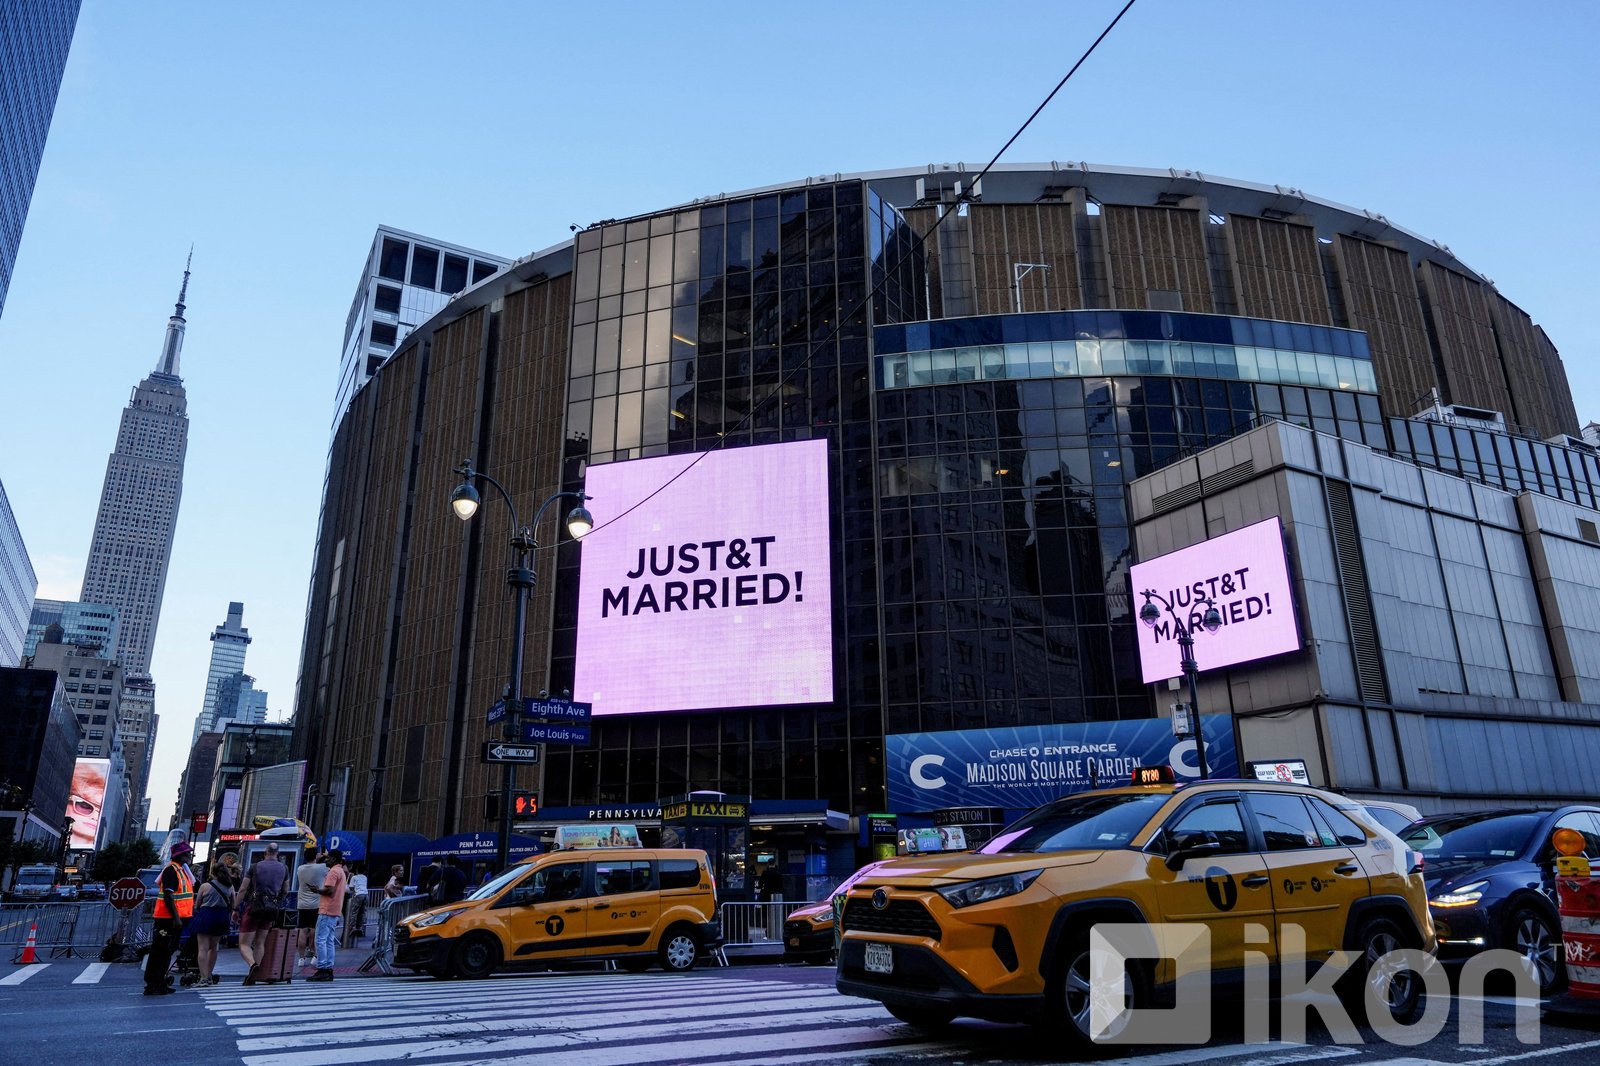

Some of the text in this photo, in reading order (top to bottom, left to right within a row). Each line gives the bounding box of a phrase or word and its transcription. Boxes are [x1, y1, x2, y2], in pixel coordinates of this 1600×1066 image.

[626, 536, 776, 579] JUST&T
[602, 571, 803, 618] MARRIED!
[1165, 567, 1249, 612] JUST&T
[1153, 592, 1272, 644] MARIED!
[531, 702, 585, 716] Eighth Ave
[530, 728, 545, 738] Joe
[547, 728, 569, 739] Louis
[496, 748, 530, 757] ONE WAY
[989, 743, 1117, 759] CHASE ENTRANCE
[909, 754, 946, 790] C
[966, 762, 1028, 784] MADISON
[1031, 759, 1082, 780] SQUARE
[1141, 769, 1160, 783] 8Y80
[530, 798, 537, 813] 5
[664, 806, 680, 819] TAXI
[693, 803, 727, 816] TAXI
[949, 810, 983, 823] STATION
[330, 836, 340, 849] D
[476, 840, 494, 848] PLAZA
[111, 887, 144, 900] STOP
